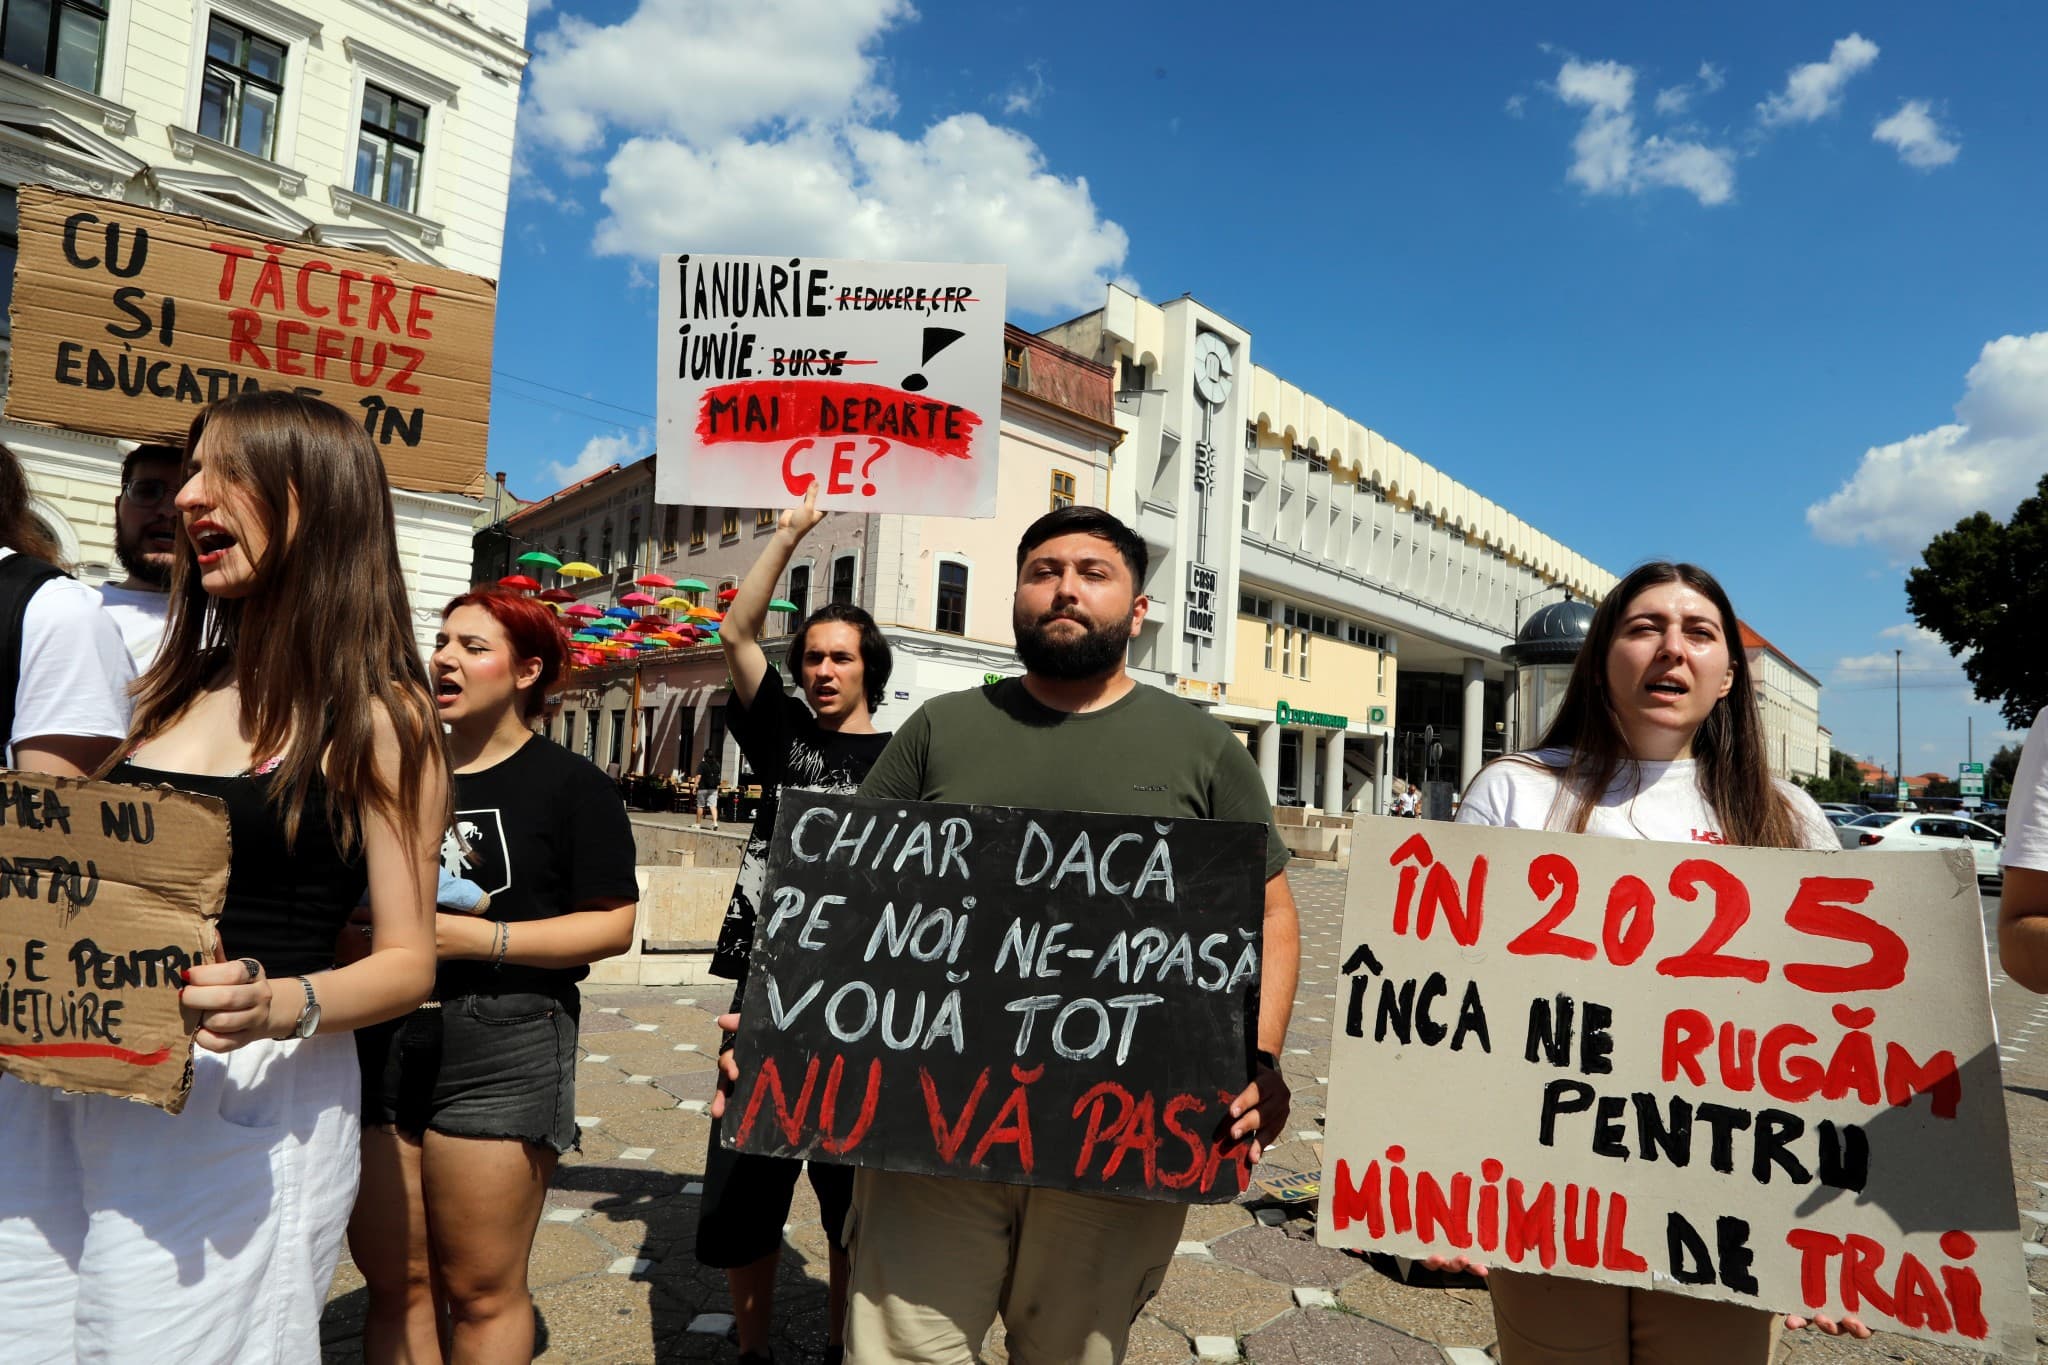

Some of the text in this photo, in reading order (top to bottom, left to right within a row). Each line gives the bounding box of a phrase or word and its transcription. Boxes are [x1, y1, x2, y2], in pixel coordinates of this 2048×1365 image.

[62, 212, 438, 340] CU TĂCERE
[228, 307, 426, 395] REFUZ
[772, 347, 848, 378] BURSE
[359, 394, 425, 447] ÎN
[708, 393, 965, 440] MAI DEPARTE
[1189, 610, 1213, 633] MODE
[1198, 590, 1210, 611] DE
[101, 801, 155, 844] NU
[791, 808, 1175, 902] CHIAR DACĂ
[767, 886, 848, 950] PE
[864, 896, 977, 963] NOI
[1389, 832, 1909, 993] ÎN 2025
[766, 970, 1165, 1066] VOUĂ TOT
[1341, 944, 1961, 1119] ÎNCA NE RUGĂM
[736, 1054, 882, 1154] NU
[919, 1063, 1045, 1174] VĂ
[1539, 1079, 1870, 1192] PENTRU
[1332, 1144, 1990, 1340] MINIMUL DE TRAI
